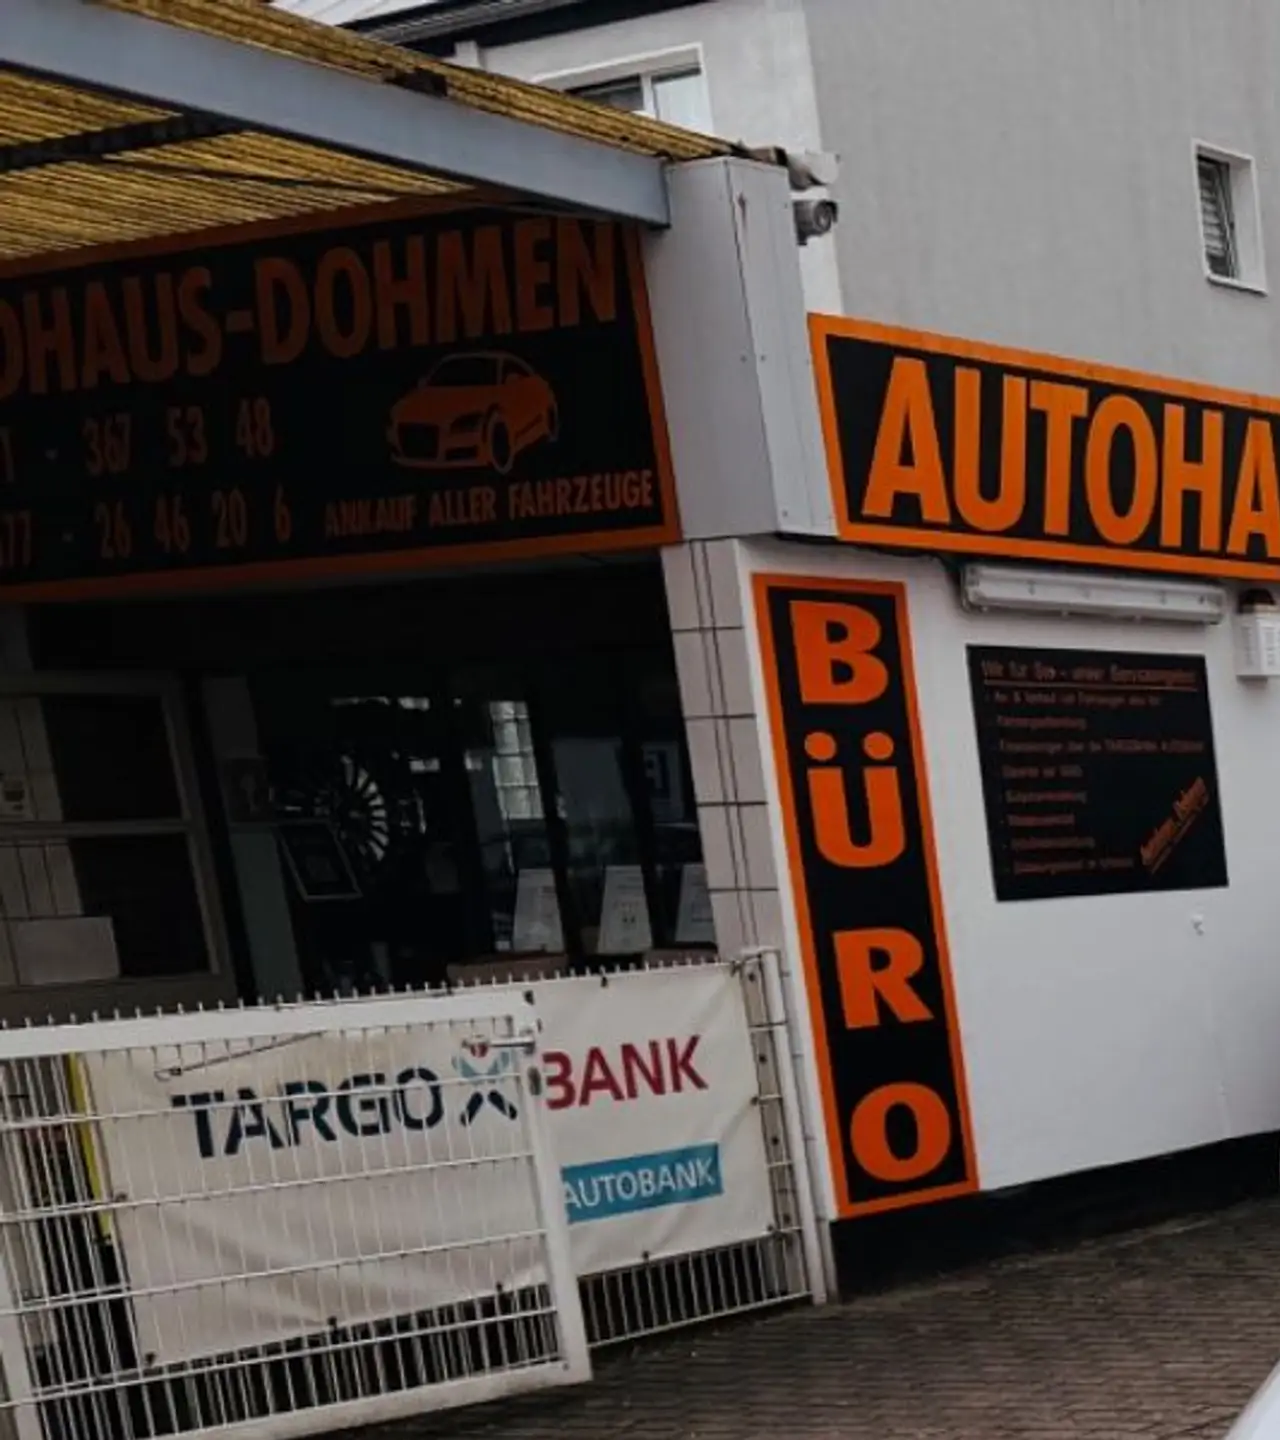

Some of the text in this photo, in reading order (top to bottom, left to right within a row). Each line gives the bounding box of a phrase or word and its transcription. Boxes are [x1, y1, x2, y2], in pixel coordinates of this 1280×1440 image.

[165, 404, 208, 467] 53
[235, 396, 275, 458] 48
[210, 486, 247, 548] 20
[272, 481, 292, 545] 6
[323, 469, 653, 540] ANKAUF ALLER FAHRZEUGE
[787, 600, 952, 1181] BÜRO
[170, 1034, 710, 1159] TARGO BANK
[563, 1157, 717, 1209] AUTOBANK
